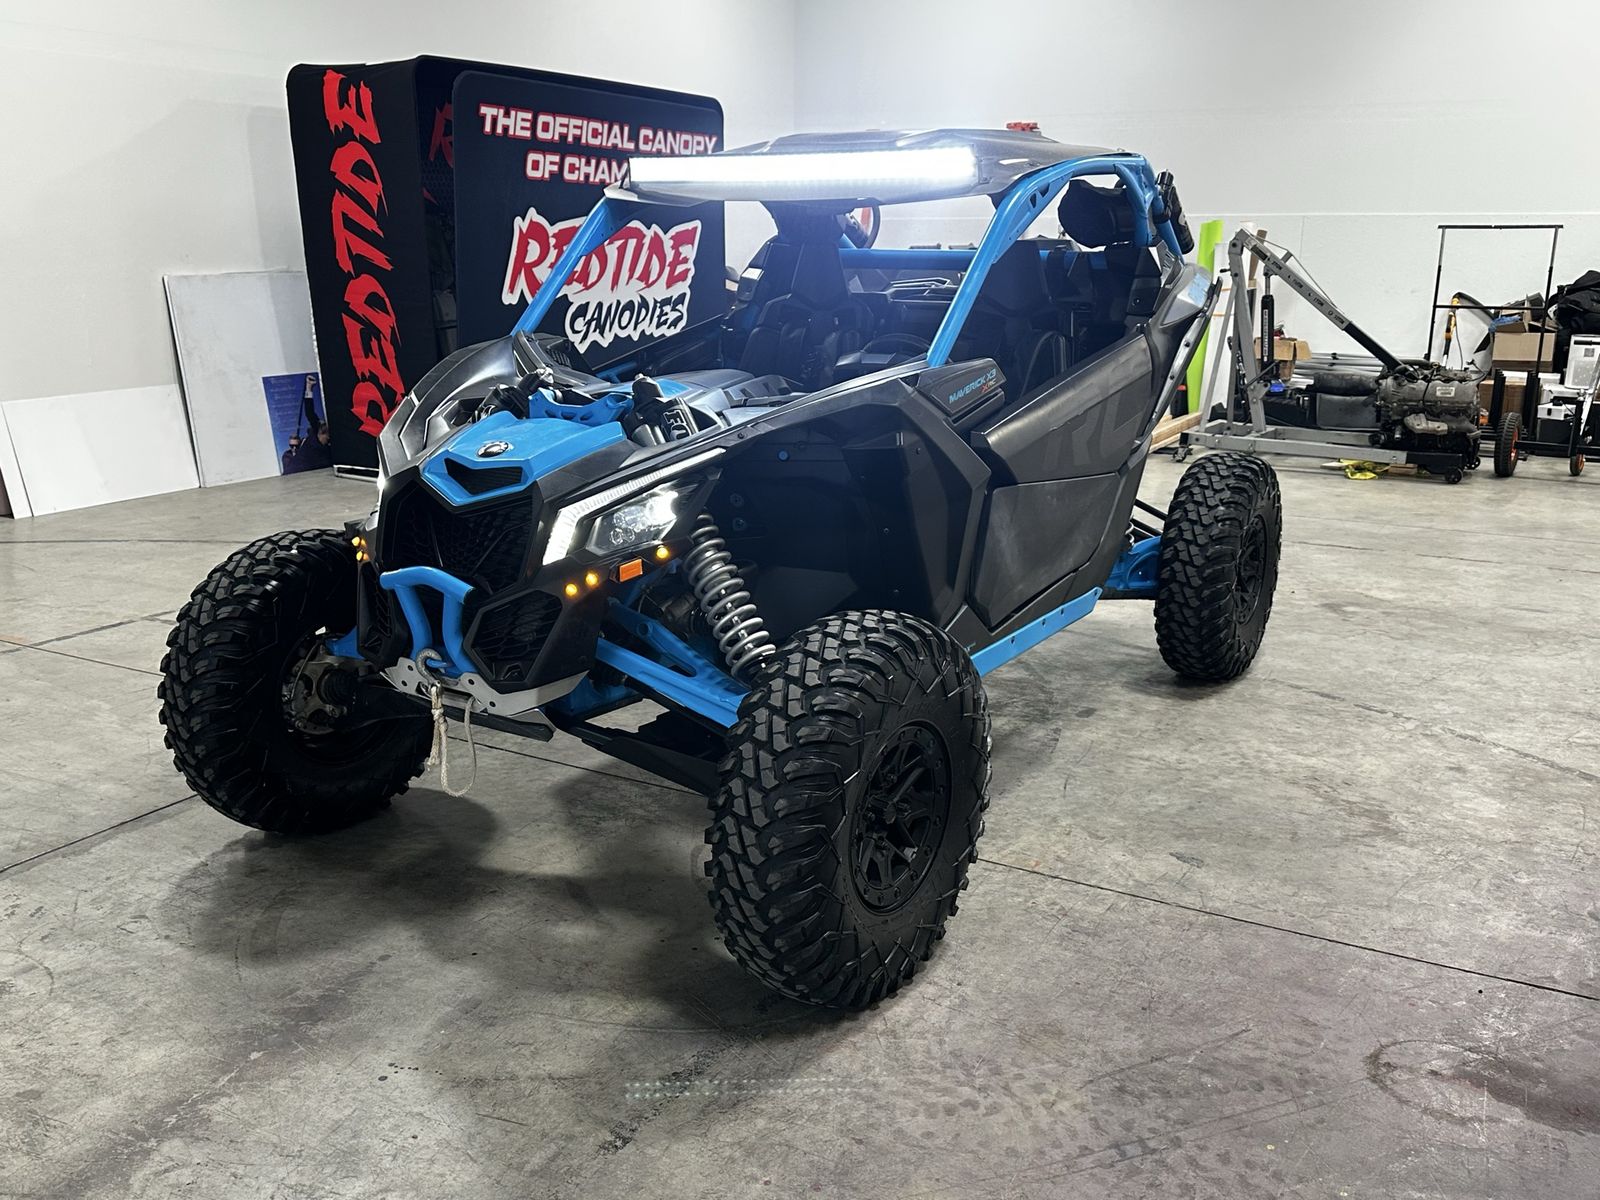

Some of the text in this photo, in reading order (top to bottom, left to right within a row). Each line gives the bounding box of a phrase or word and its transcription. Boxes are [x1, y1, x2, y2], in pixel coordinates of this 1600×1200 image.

[479, 104, 533, 138] THE
[536, 113, 636, 151] OFFICIAL
[638, 127, 718, 155] CANOPY
[525, 151, 629, 184] OF CHAM
[323, 69, 406, 438] REDTIDE
[569, 291, 689, 345] CANOPIES
[949, 374, 987, 404] MAVERICK
[663, 409, 692, 441] FO
